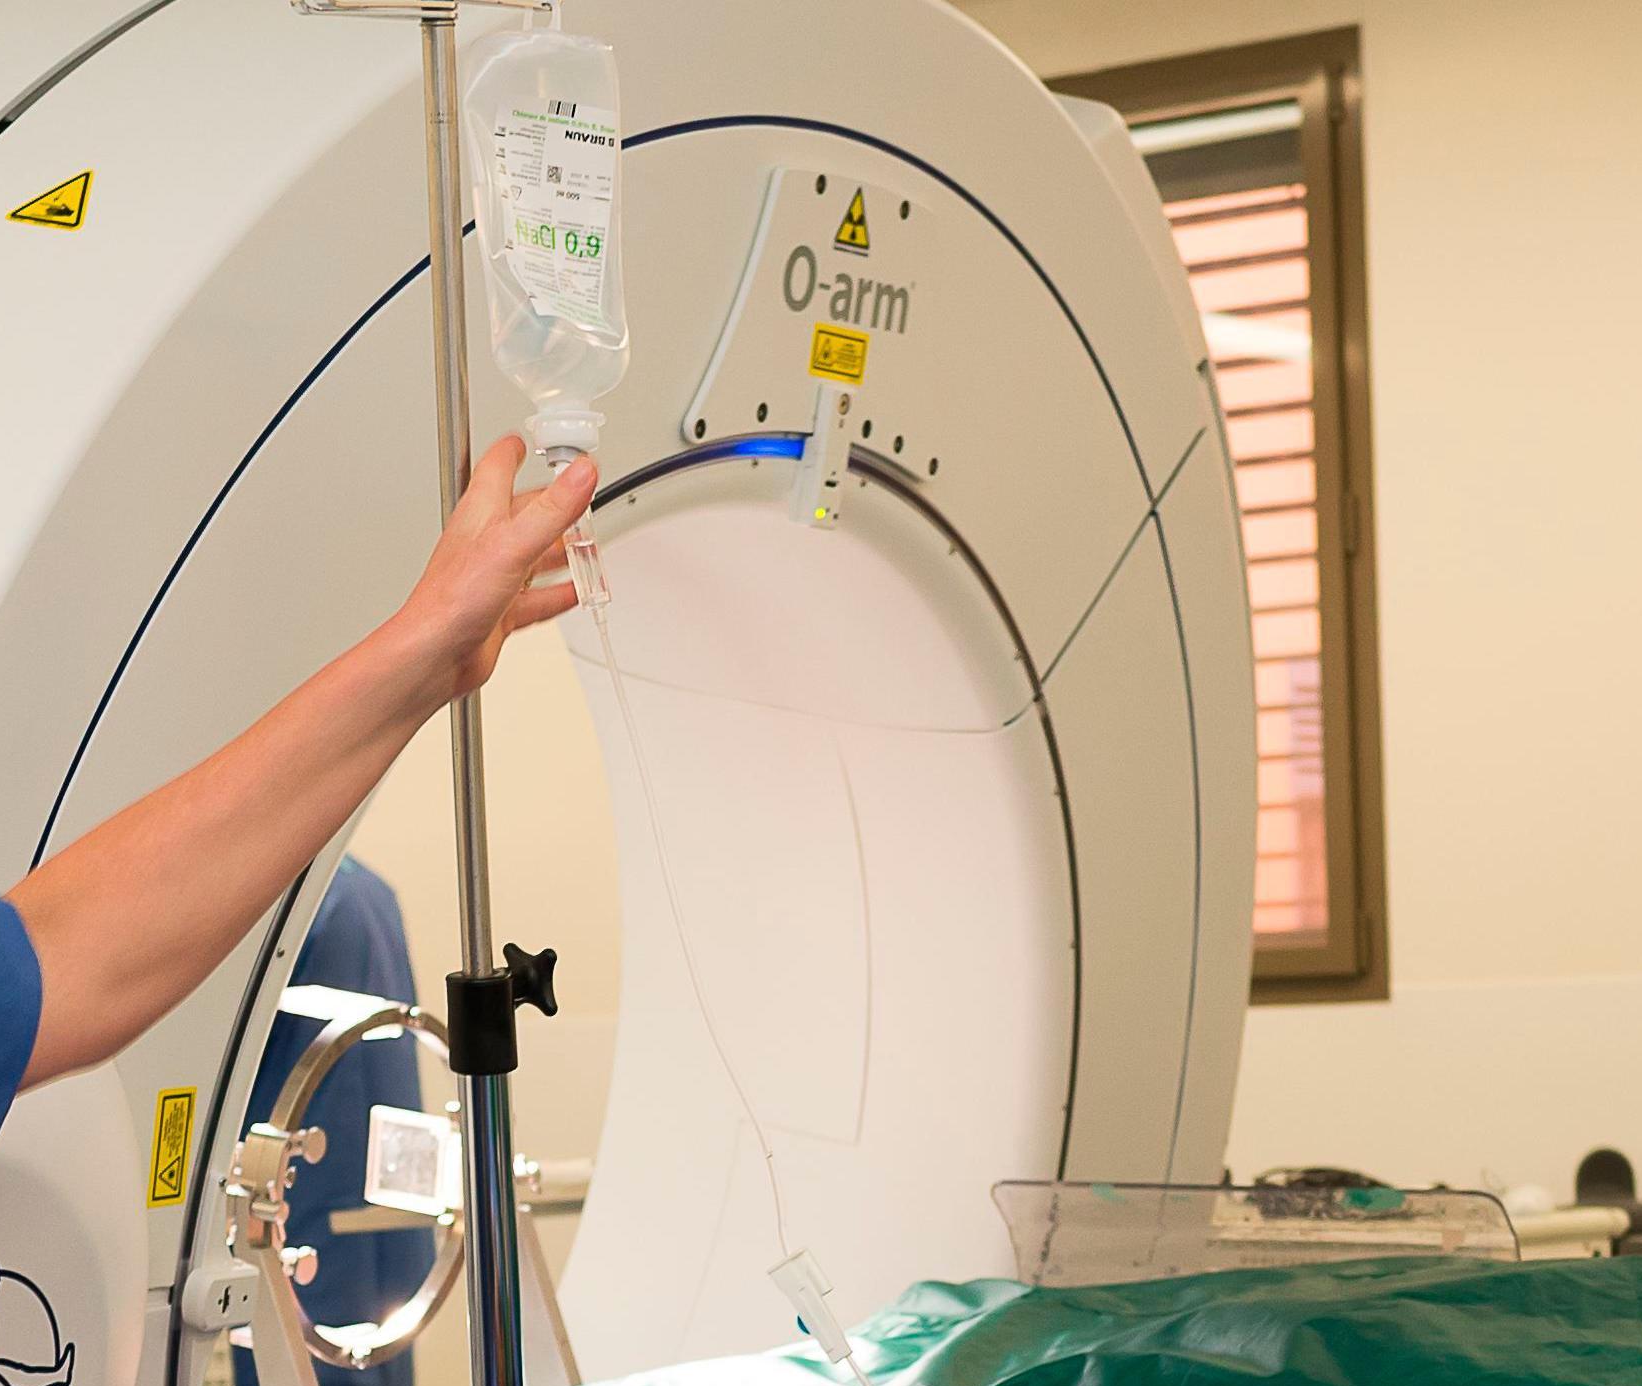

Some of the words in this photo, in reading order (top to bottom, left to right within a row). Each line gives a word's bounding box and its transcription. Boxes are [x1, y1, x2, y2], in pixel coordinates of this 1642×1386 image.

[564, 130, 606, 146] BRAUN
[516, 219, 556, 250] NaCl
[564, 230, 601, 258] 0,9
[783, 245, 909, 334] O-arm
